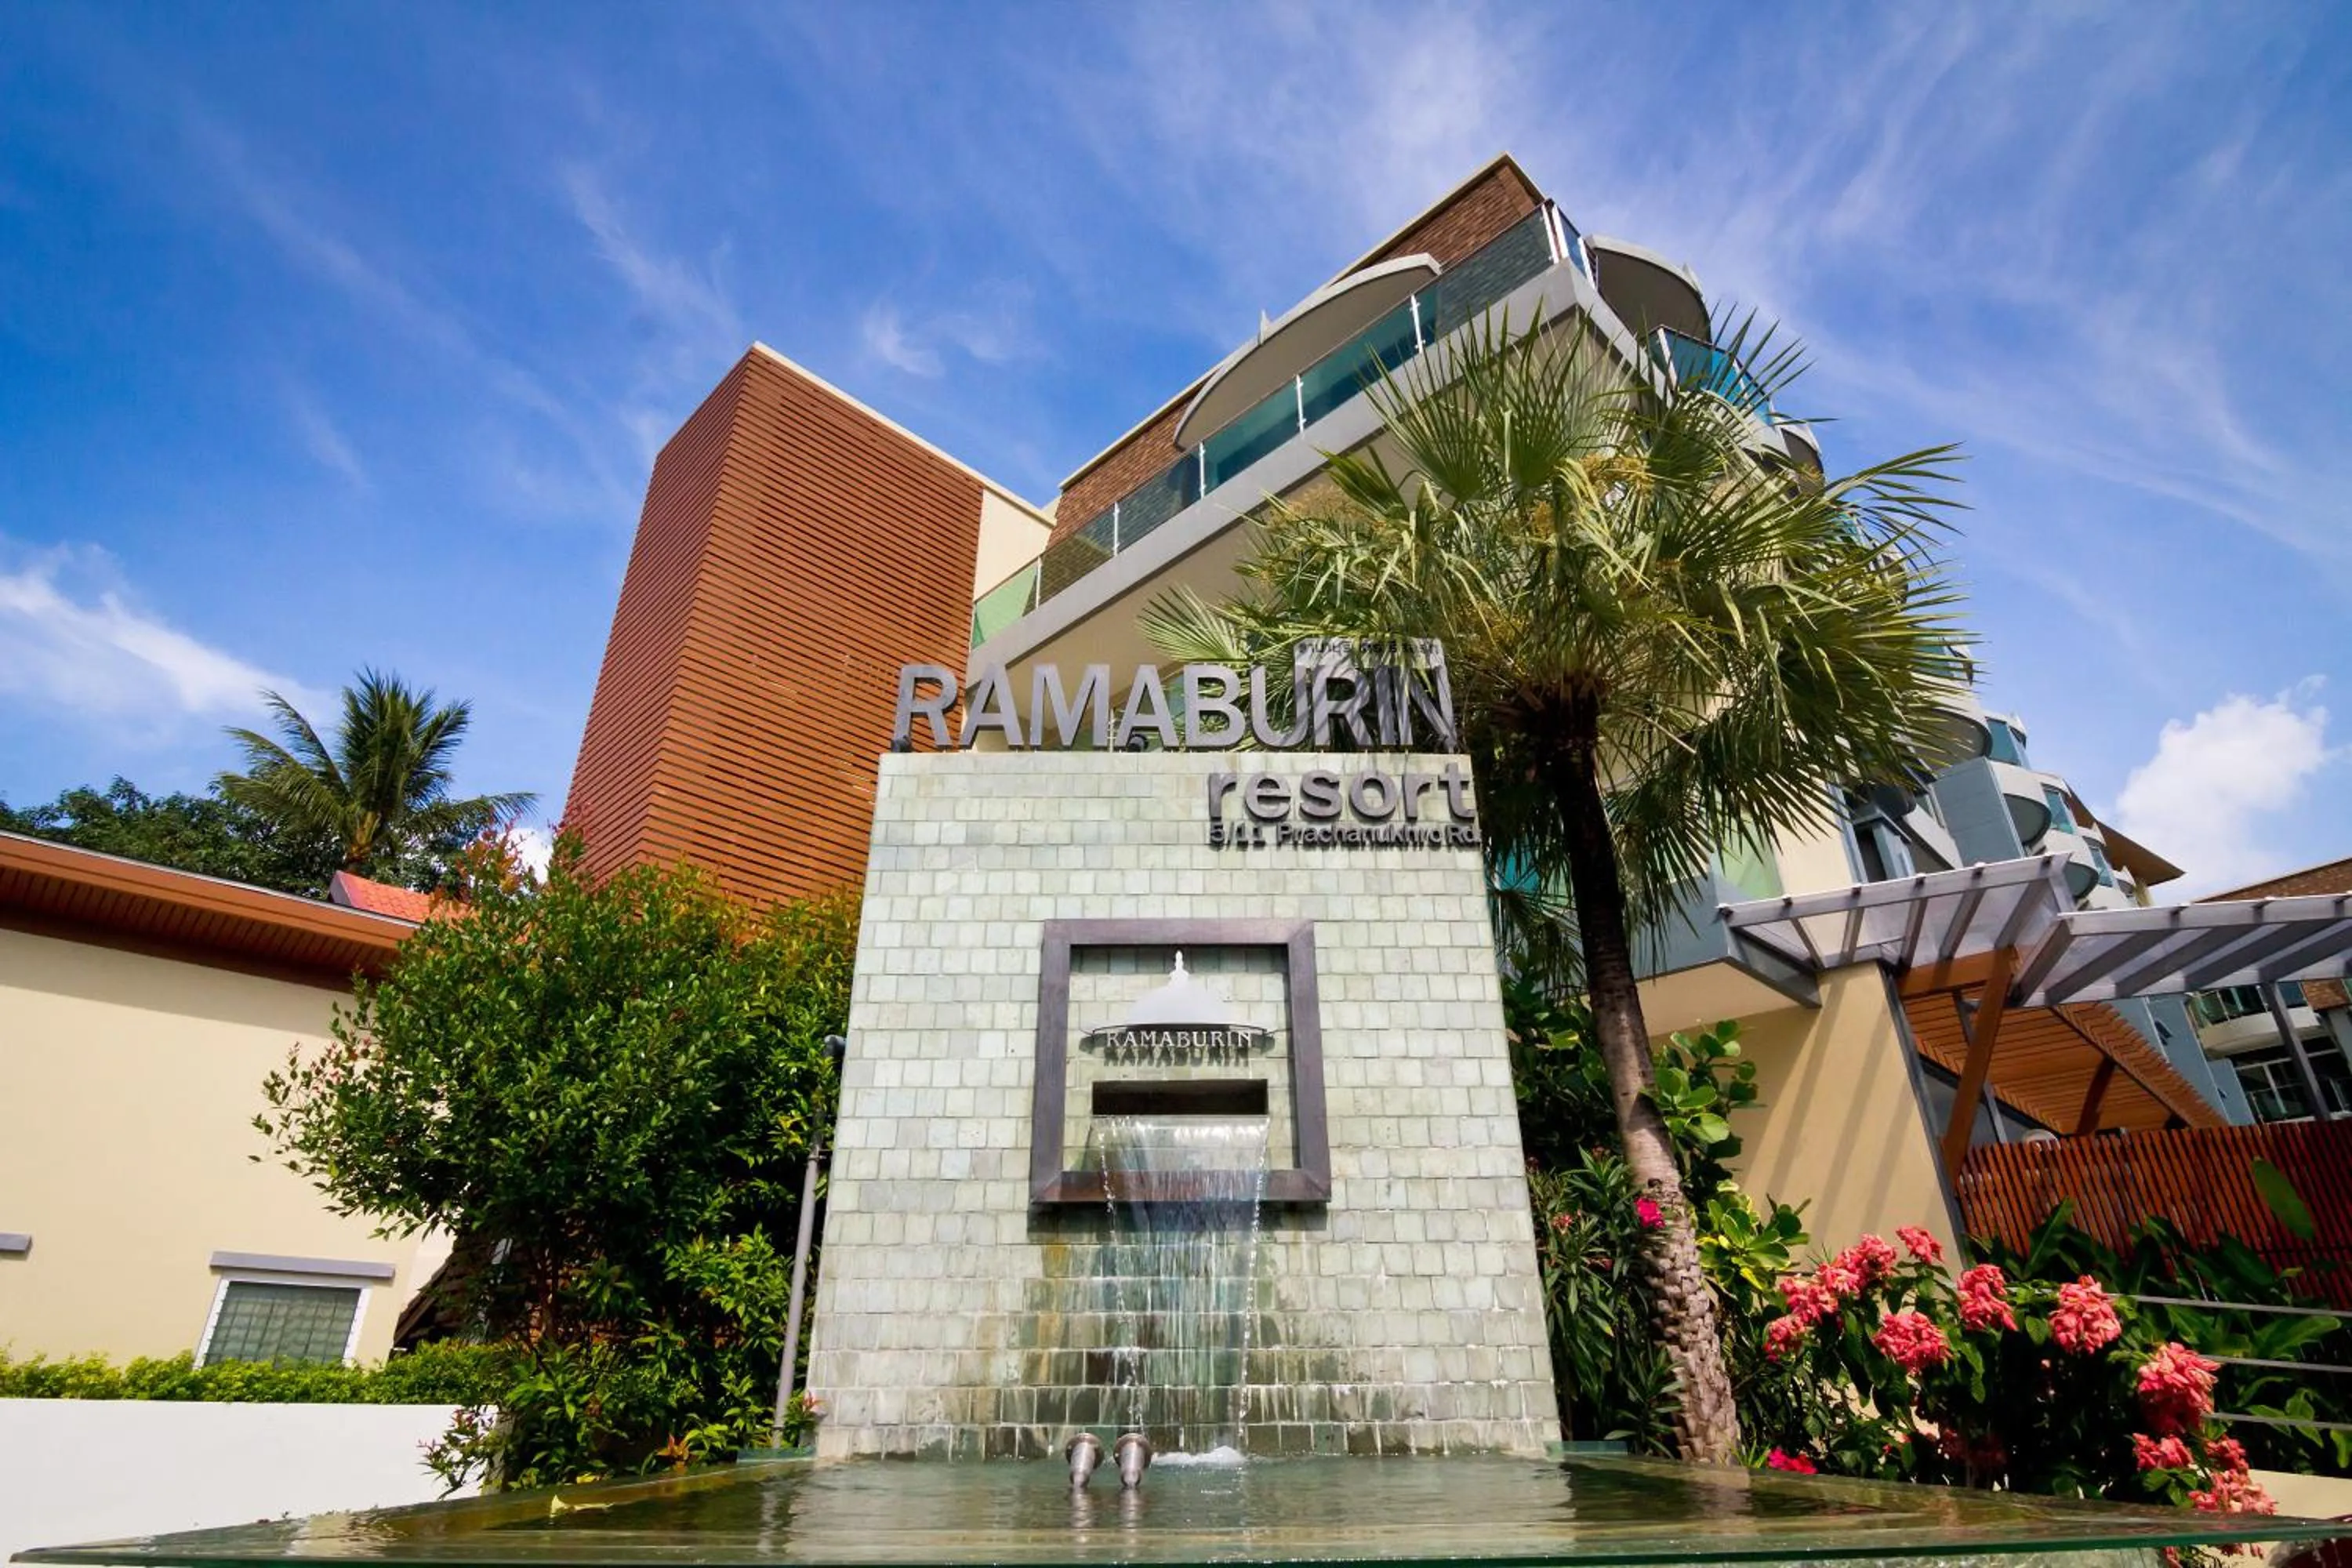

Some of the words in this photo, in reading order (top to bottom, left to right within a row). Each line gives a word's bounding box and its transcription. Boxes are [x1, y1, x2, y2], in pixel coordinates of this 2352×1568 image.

[894, 662, 1457, 750] RAMABURIN
[1208, 763, 1476, 821] resort
[1210, 823, 1265, 844] 5/11
[1106, 1030, 1253, 1048] RAMABURIN
